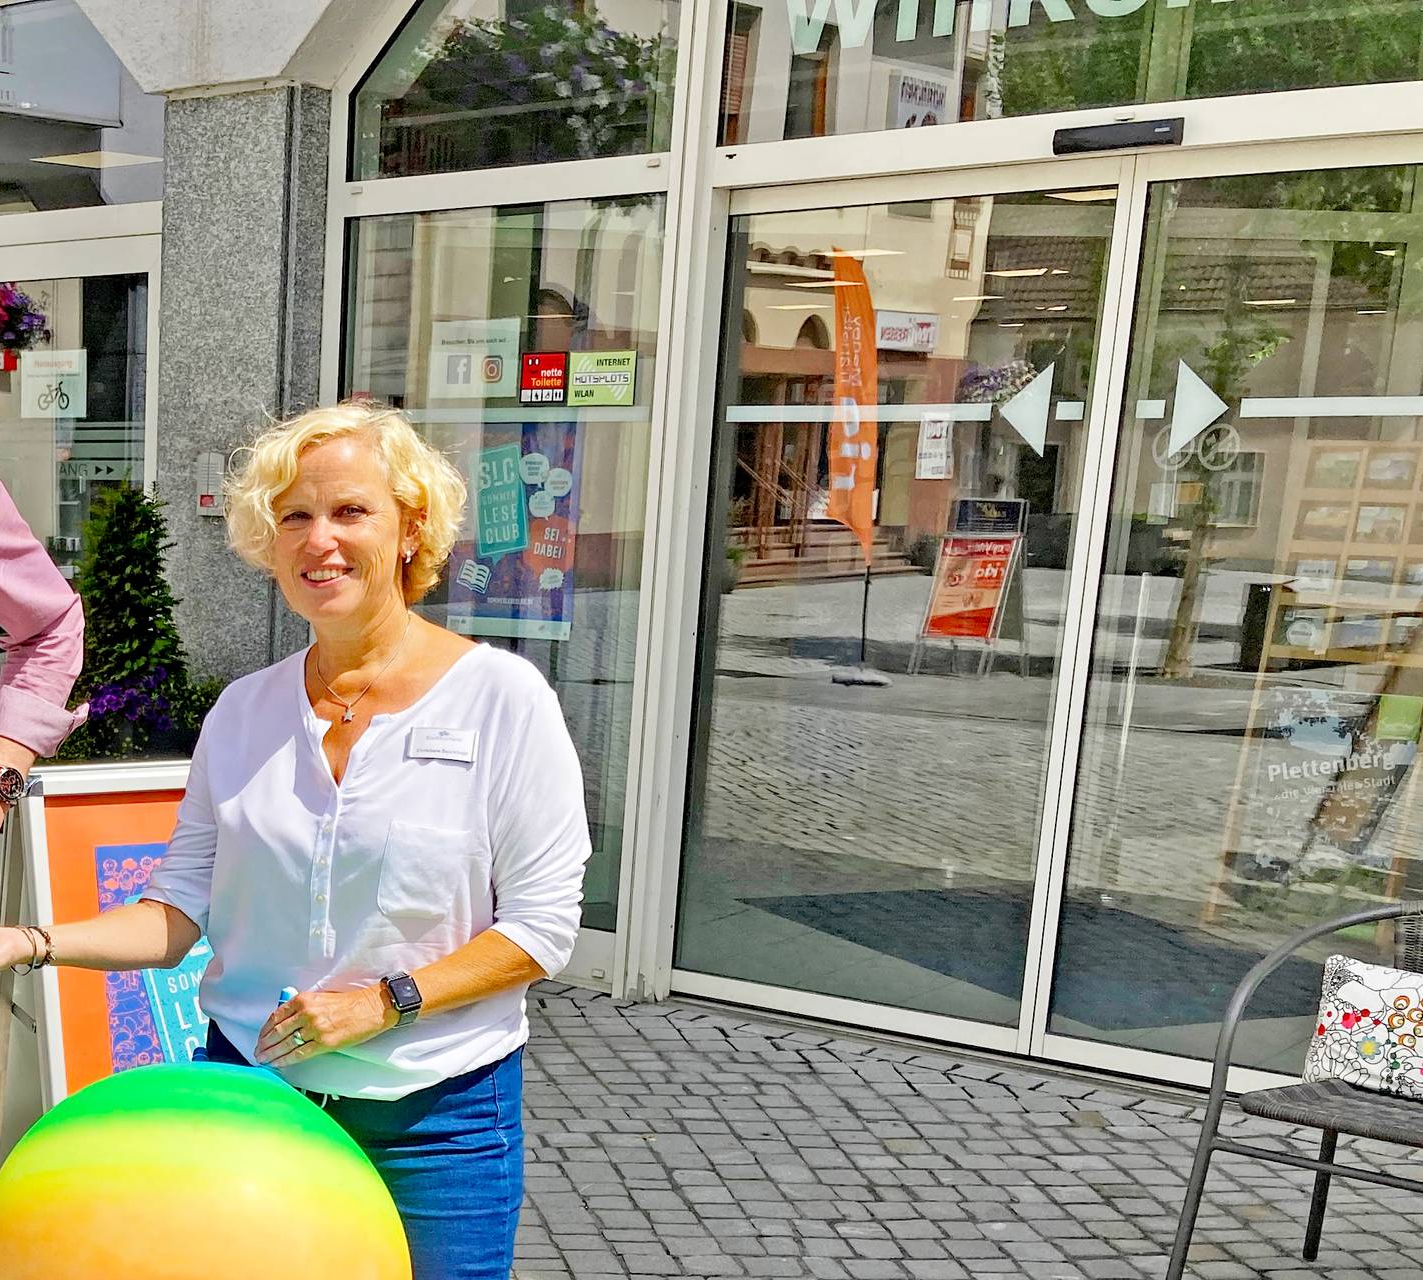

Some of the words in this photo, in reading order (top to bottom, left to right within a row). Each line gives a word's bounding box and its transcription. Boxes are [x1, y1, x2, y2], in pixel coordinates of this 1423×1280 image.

[596, 358, 631, 366] INTERNET
[540, 368, 563, 377] nette
[530, 377, 562, 387] Toilette
[574, 389, 595, 398] WLAN
[483, 503, 519, 525] LESE
[485, 523, 520, 545] CLUB
[544, 526, 561, 542] SEI
[1266, 750, 1397, 783] Plettenberg
